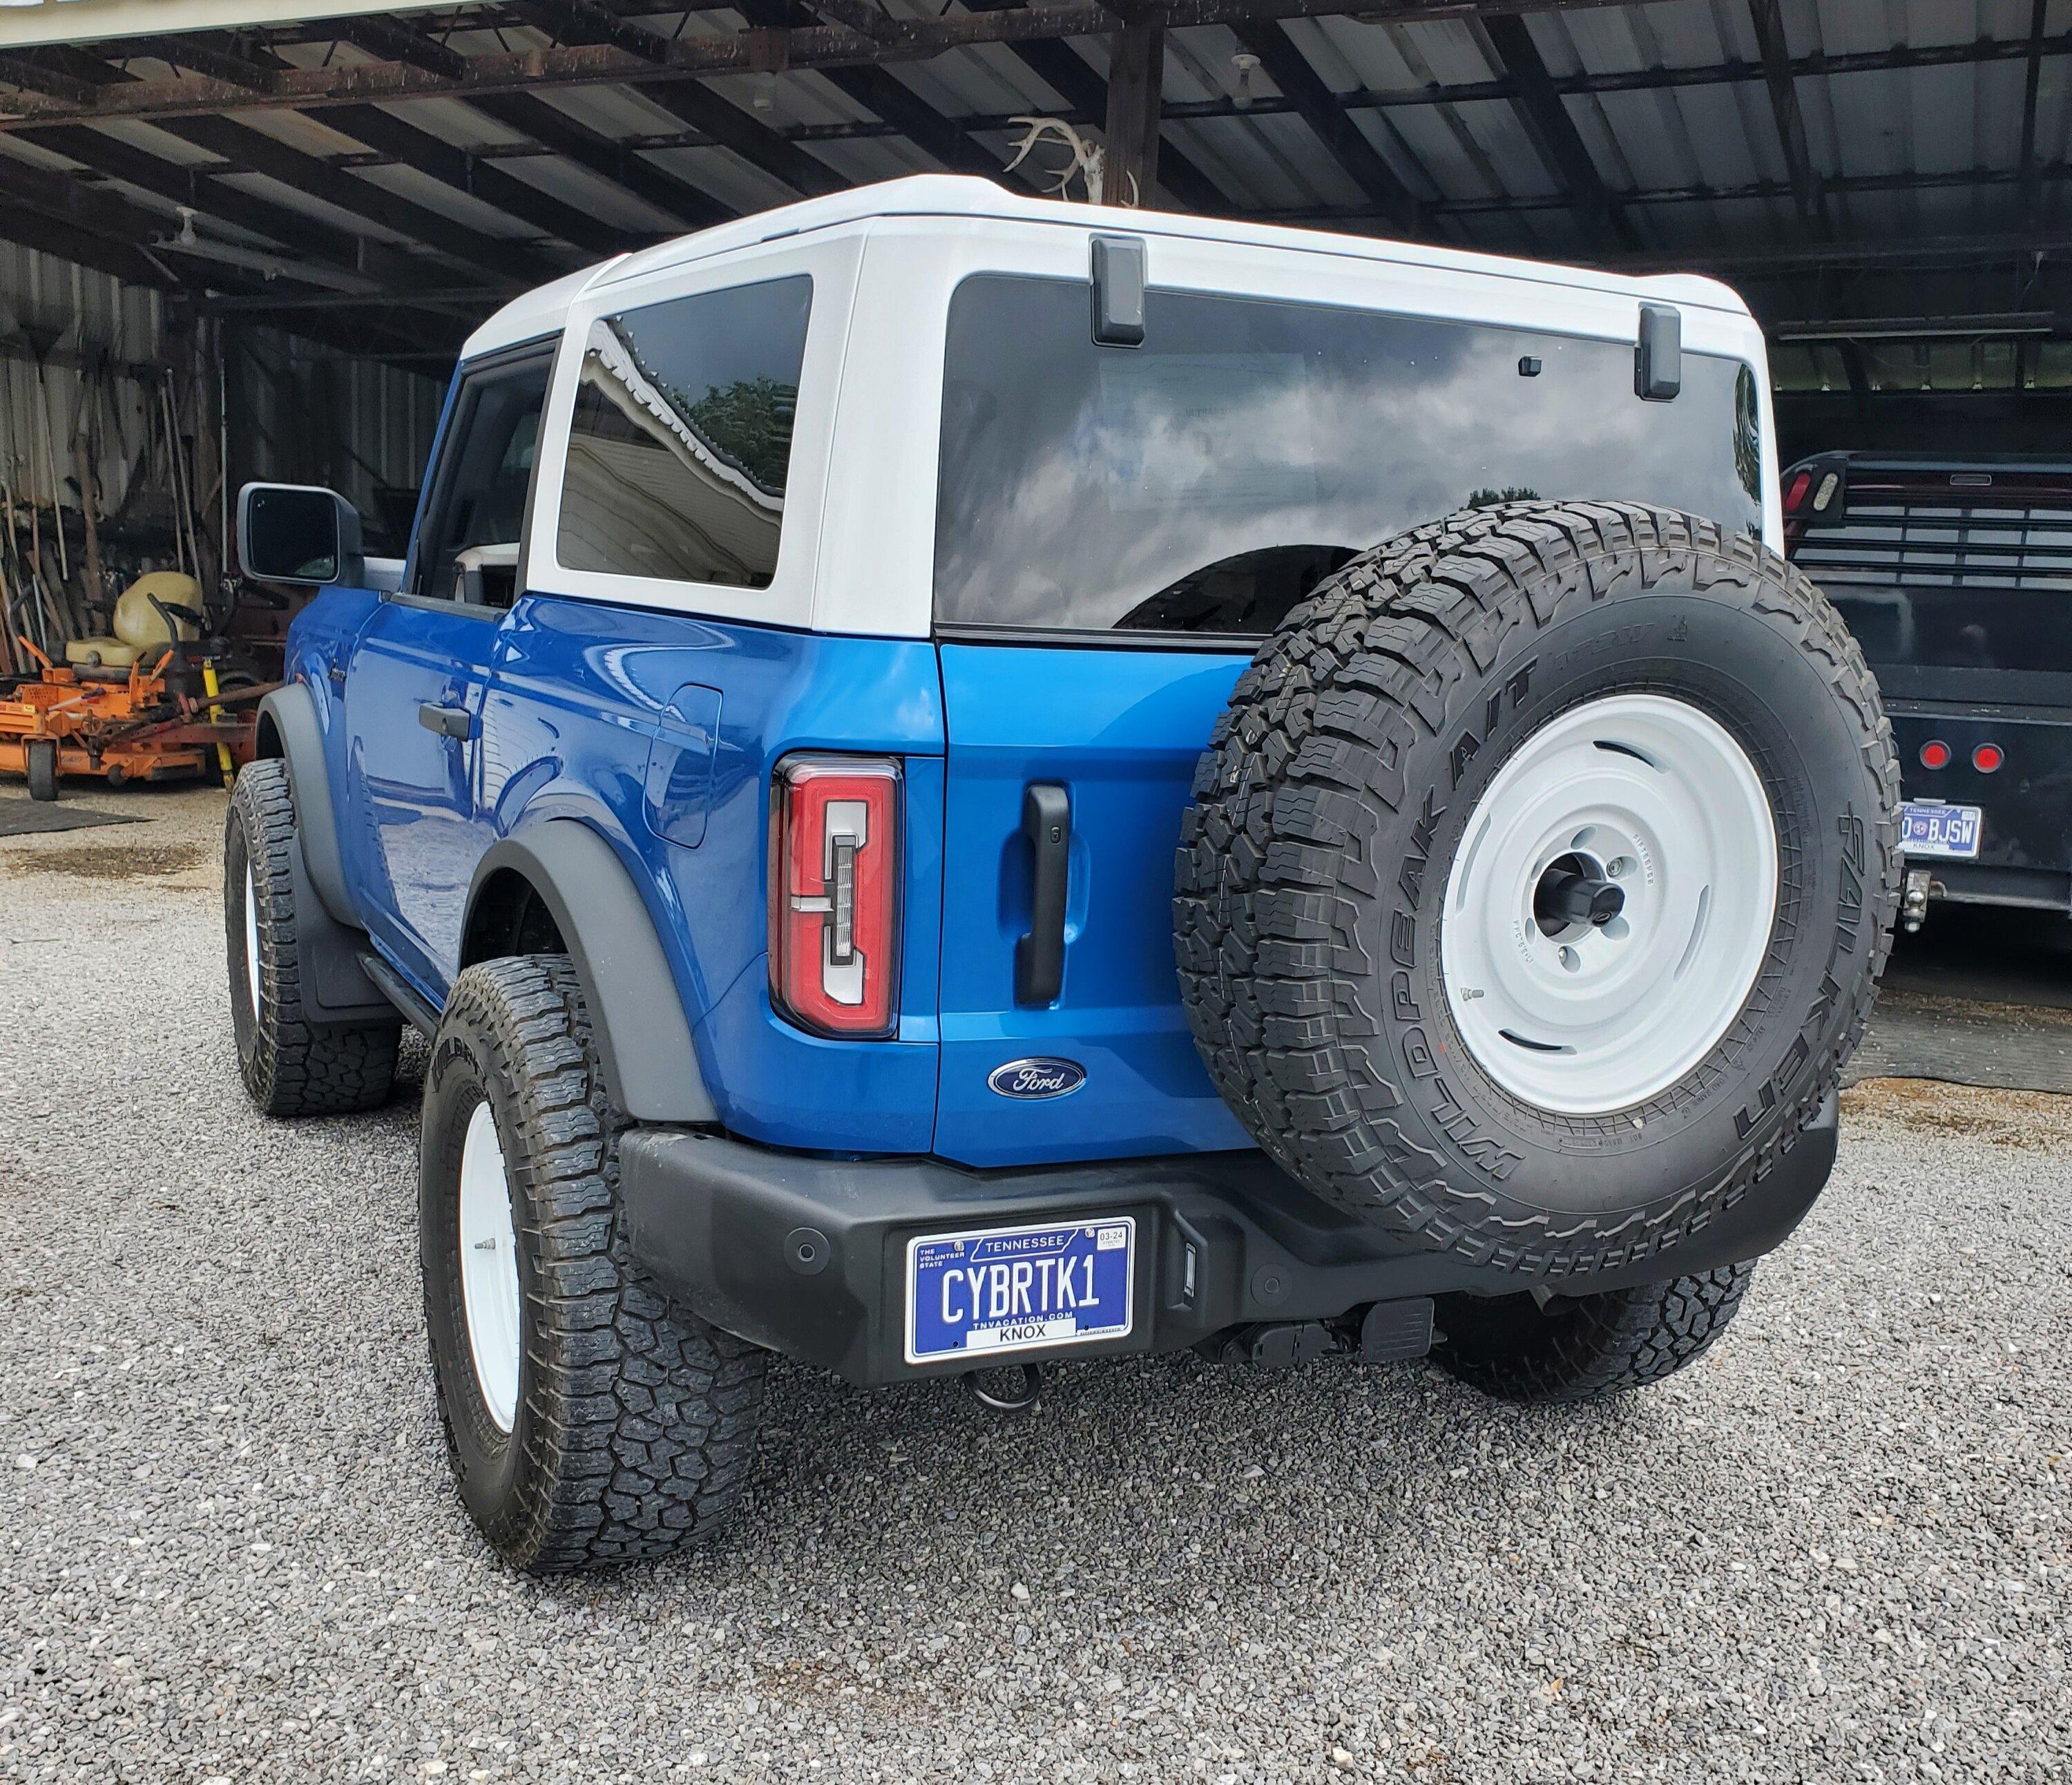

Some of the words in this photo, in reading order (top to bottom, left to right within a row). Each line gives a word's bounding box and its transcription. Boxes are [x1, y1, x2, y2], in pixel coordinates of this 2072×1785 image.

[1449, 655, 1539, 792] A/T
[1928, 818, 1973, 843] BJSW
[1733, 799, 1865, 1140] FALKEN
[1390, 784, 1526, 1181] WILDPEAK
[1013, 1068, 1065, 1091] Ford
[986, 1235, 1064, 1253] TENNESSEE
[1100, 1231, 1123, 1241] 03-24
[920, 1252, 965, 1262] VOLUNTEER
[942, 1254, 1100, 1324] CYBRTK1
[972, 1312, 1073, 1330] TNVACATION.COM
[999, 1324, 1046, 1342] KNOX
